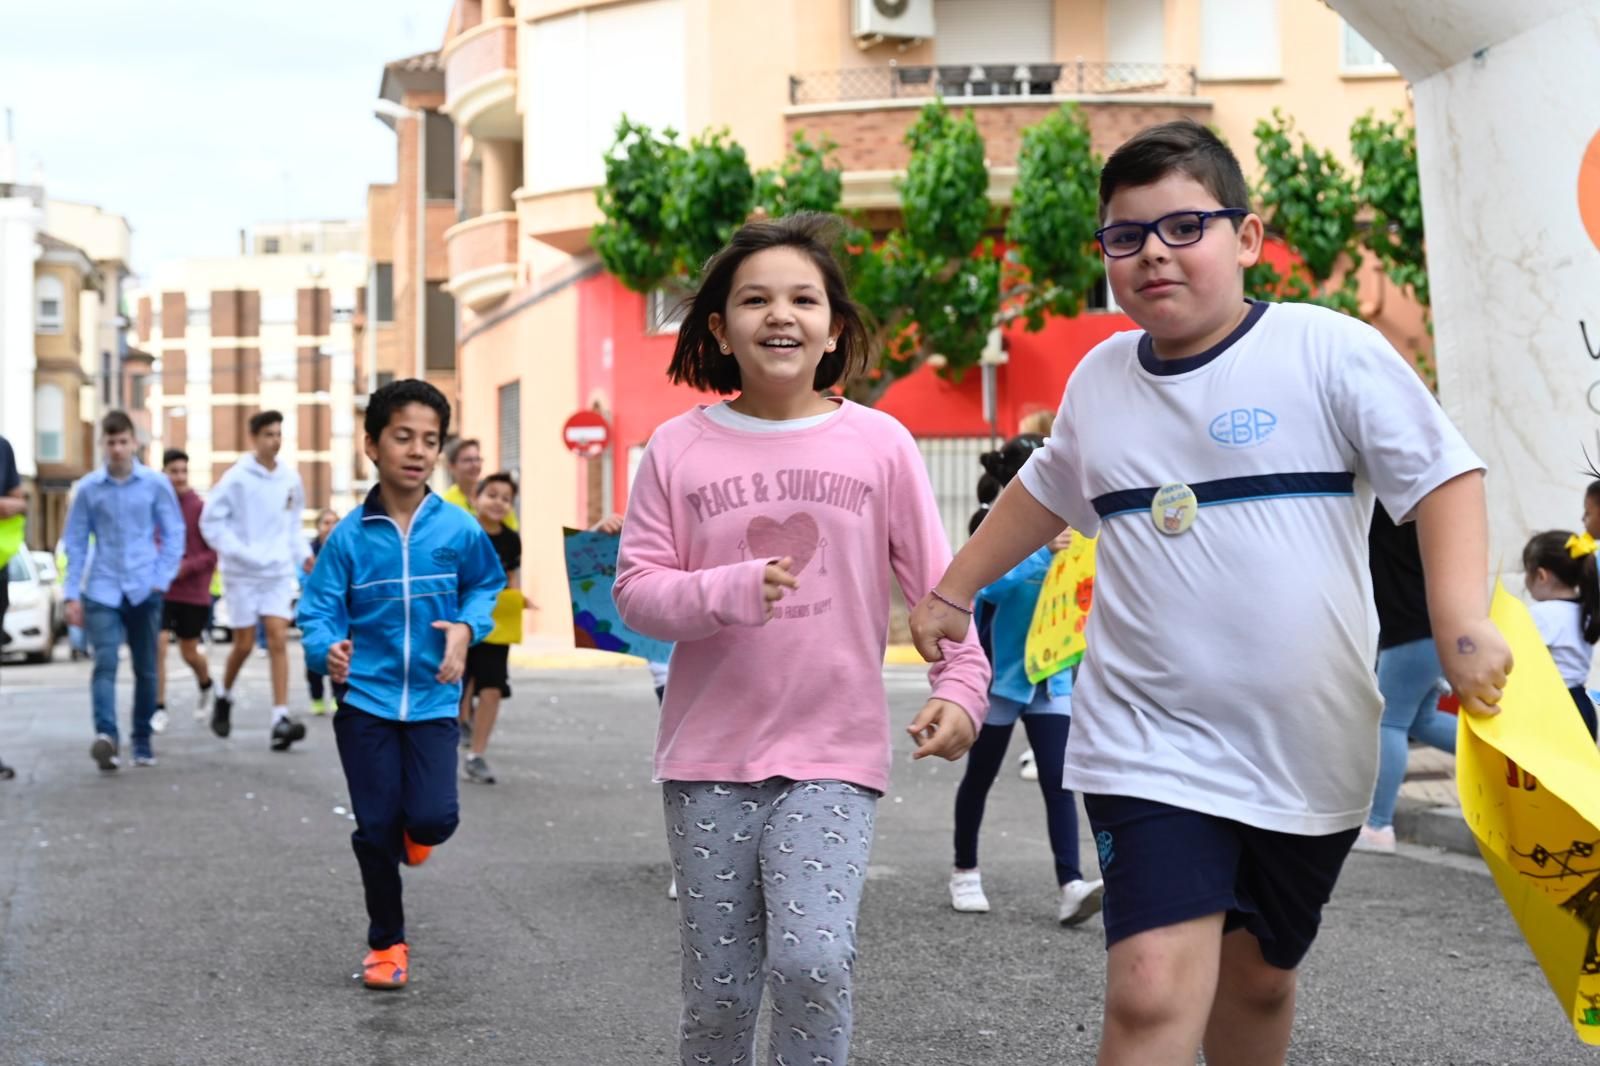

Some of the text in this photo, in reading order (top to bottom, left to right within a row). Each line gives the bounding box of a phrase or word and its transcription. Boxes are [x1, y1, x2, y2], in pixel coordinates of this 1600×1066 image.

[686, 469, 874, 522] PEACE & SUNSHINE
